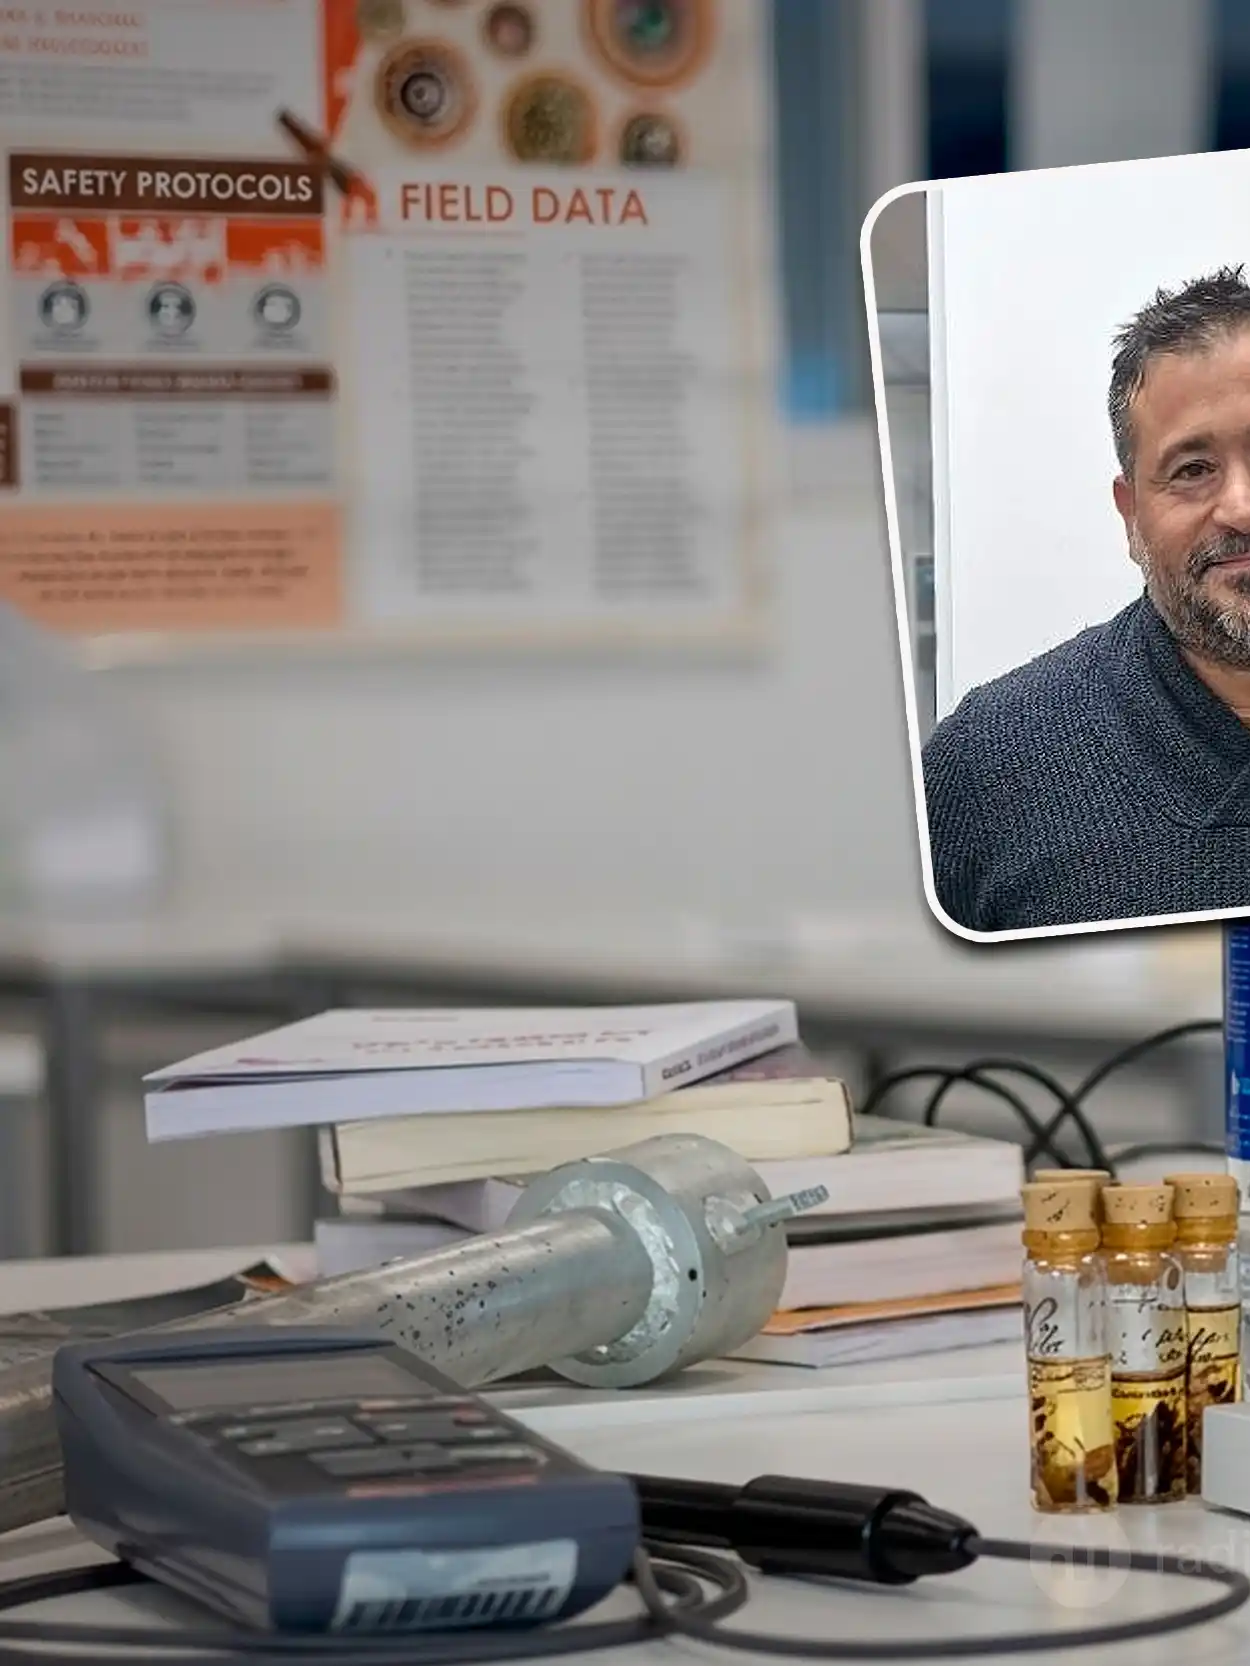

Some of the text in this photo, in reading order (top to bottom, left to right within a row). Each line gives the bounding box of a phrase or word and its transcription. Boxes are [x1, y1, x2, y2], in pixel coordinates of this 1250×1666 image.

[22, 167, 313, 202] SAFETY PROTOCOLS
[401, 183, 649, 225] FIELD DATA
